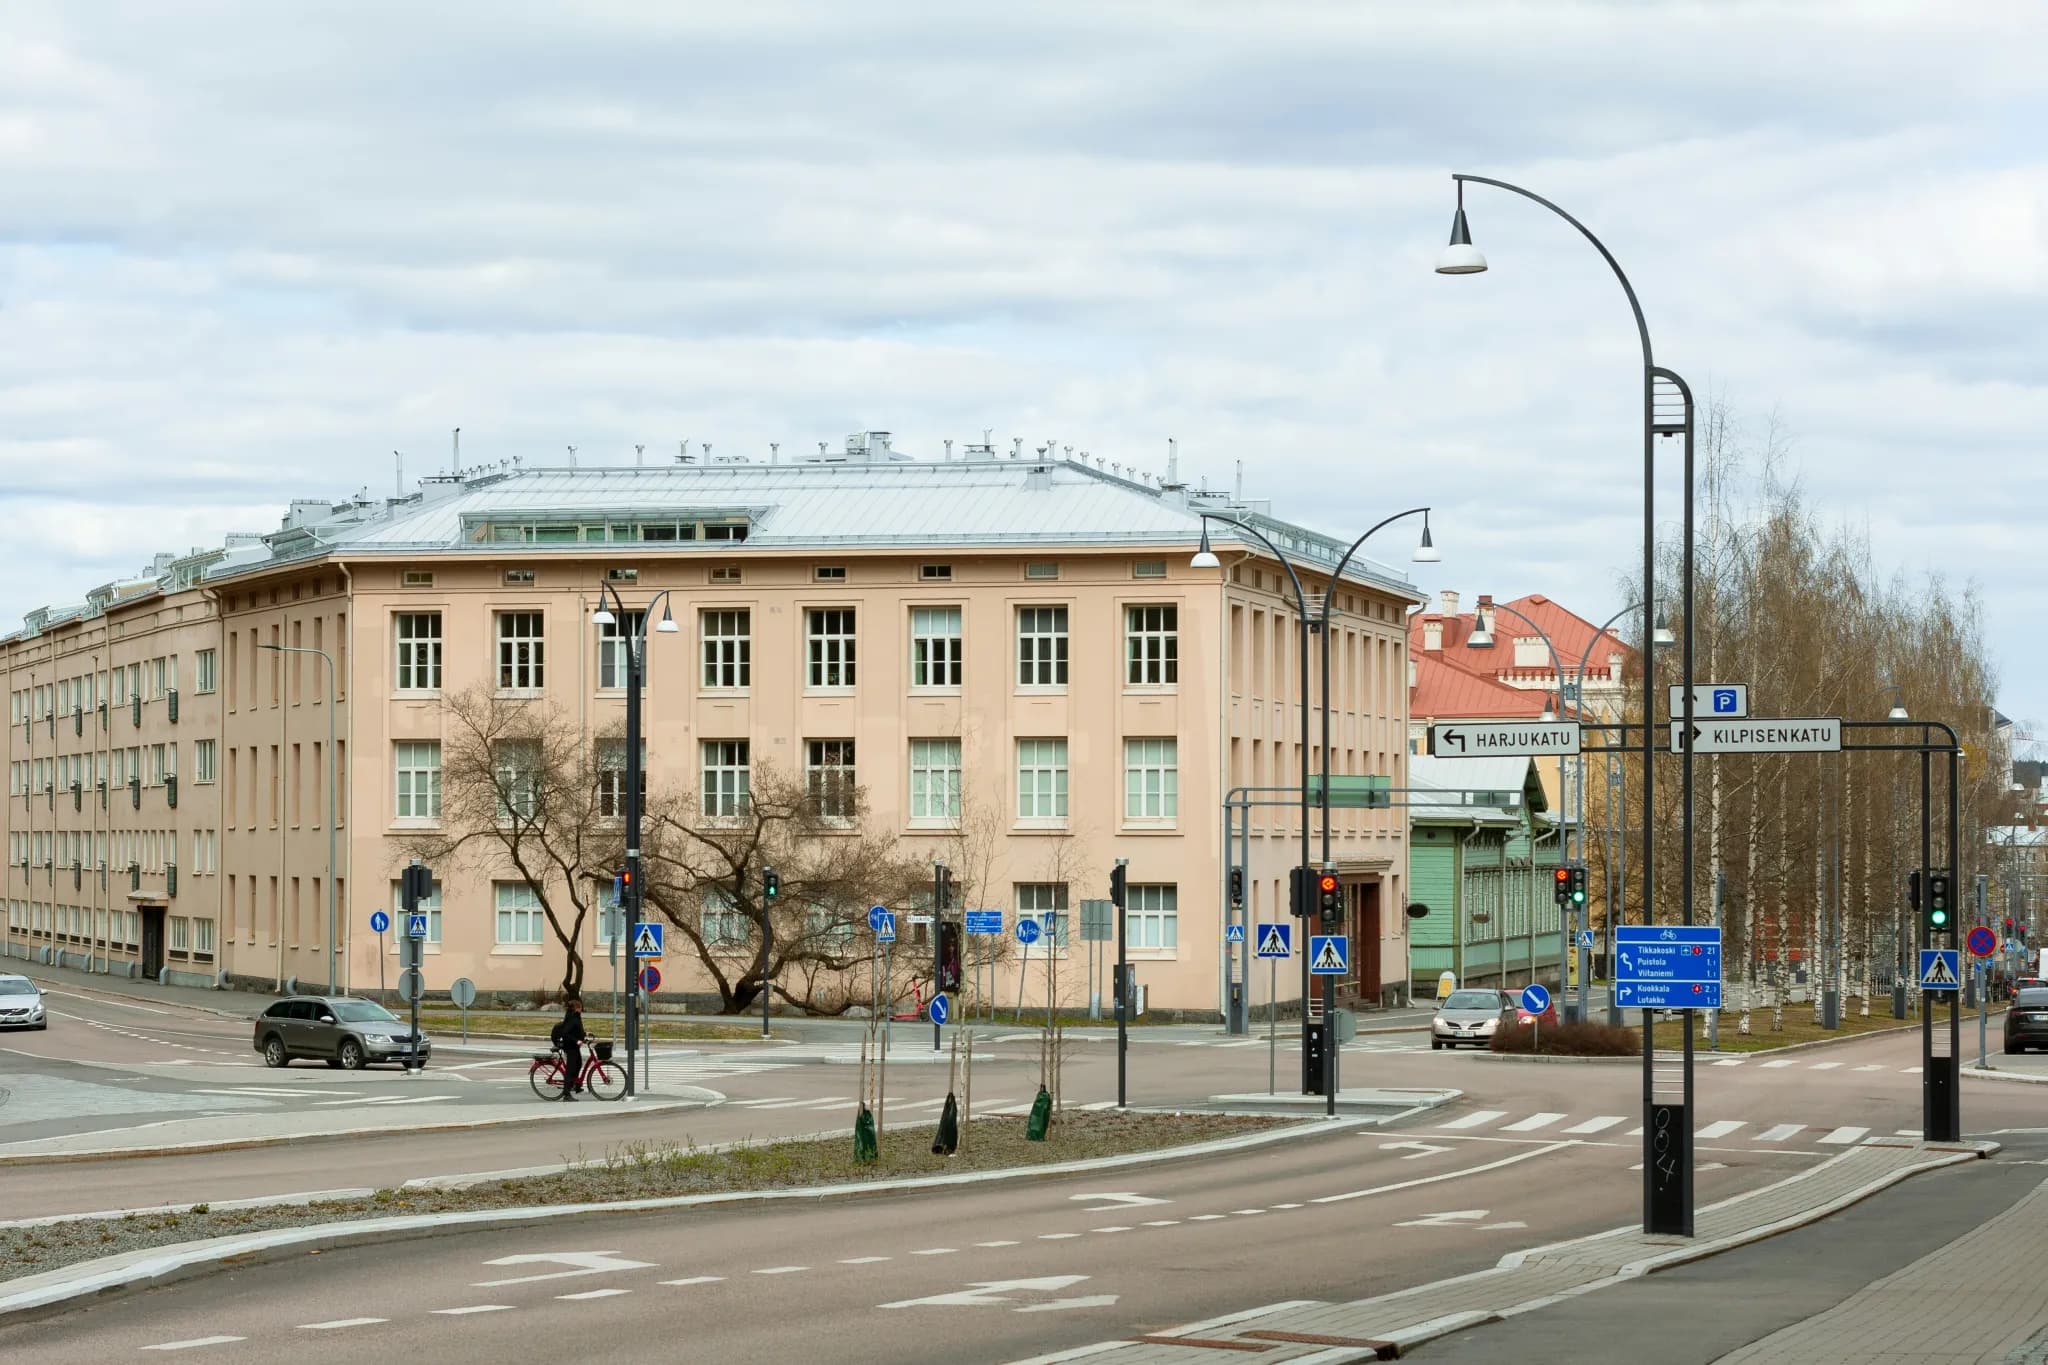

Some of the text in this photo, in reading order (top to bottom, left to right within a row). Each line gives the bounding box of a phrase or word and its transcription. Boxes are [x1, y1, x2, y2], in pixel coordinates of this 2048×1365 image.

[1719, 696, 1731, 711] P
[1475, 730, 1571, 748] HARJUKATU
[1713, 727, 1831, 744] KILPISENKATU
[1638, 946, 1675, 954] Tikkakoski
[1637, 958, 1666, 966] Puistola
[1637, 969, 1674, 977] Viitaniemi
[1637, 984, 1670, 993] Kuokkala
[1637, 996, 1665, 1004] Lutakko
